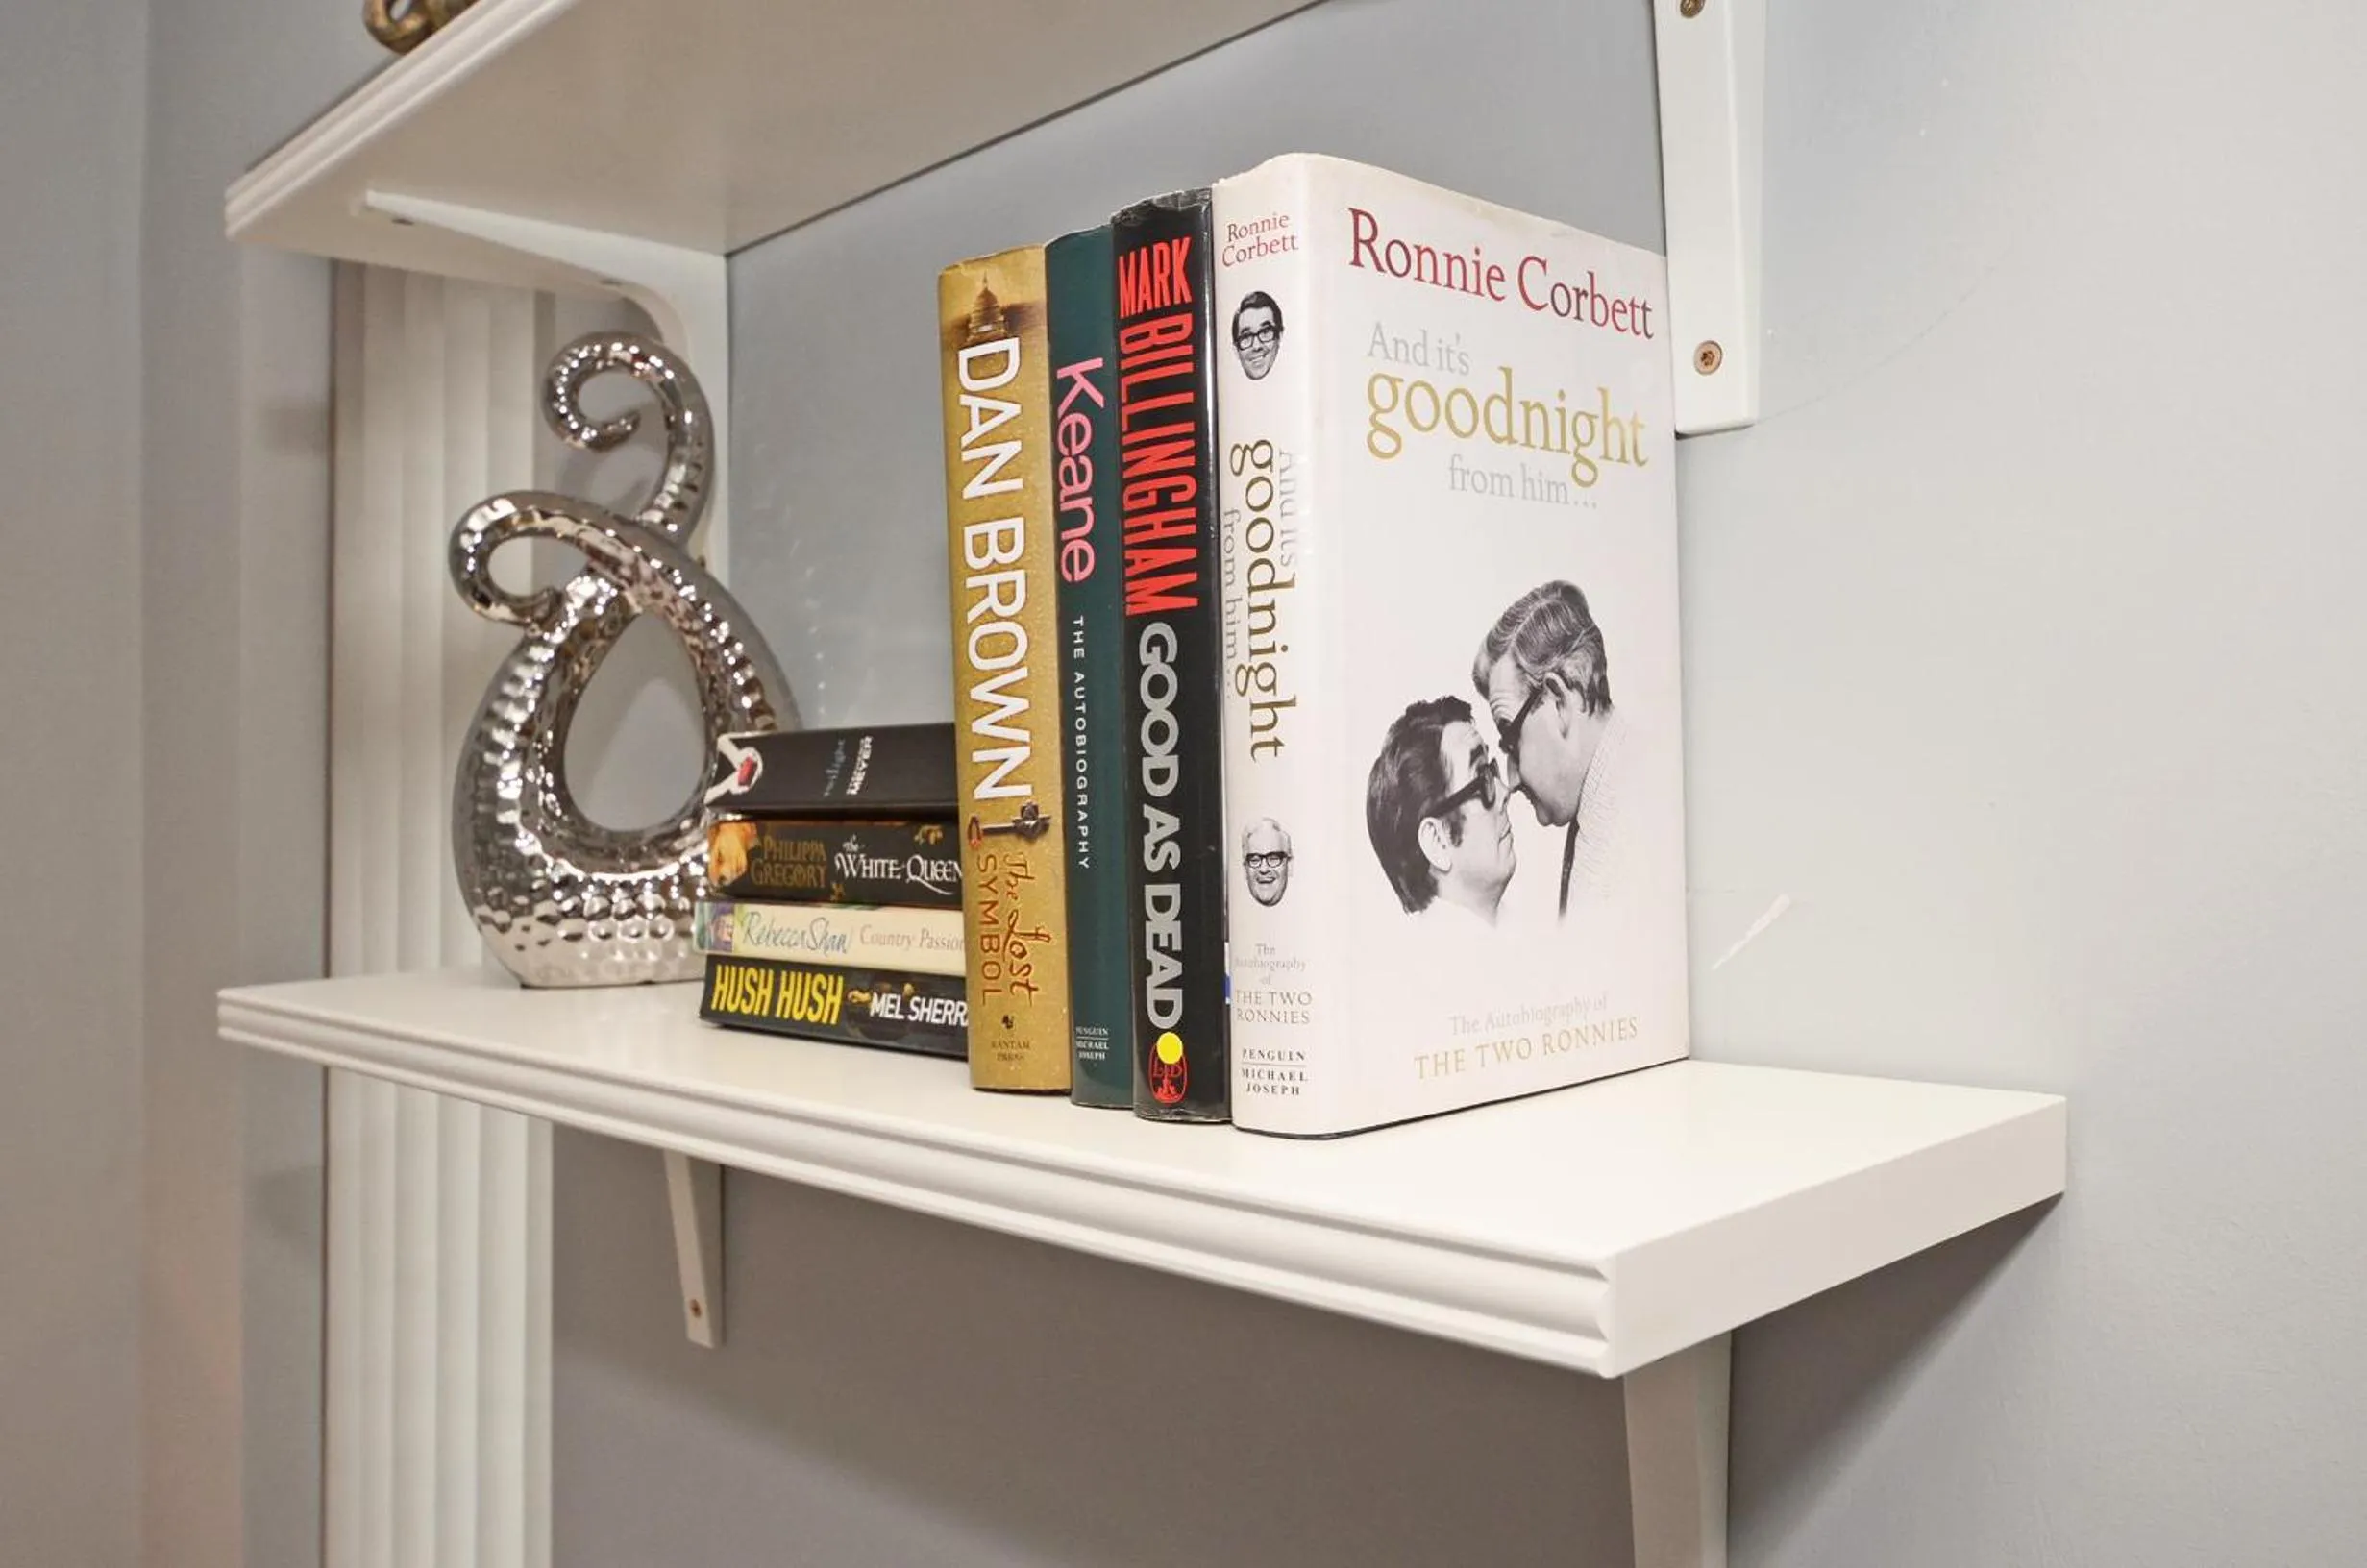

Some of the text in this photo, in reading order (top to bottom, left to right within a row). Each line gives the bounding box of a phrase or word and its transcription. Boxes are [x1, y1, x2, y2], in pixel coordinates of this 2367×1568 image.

[1221, 211, 1299, 267] Ronnie Corbett
[1348, 207, 1654, 339] Ronnie Corbett
[1367, 321, 1471, 377] And it's
[1119, 237, 1199, 616] MARK BILLINGHAM
[1366, 365, 1649, 488] goodnight
[1057, 357, 1105, 582] Keane
[1448, 453, 1516, 499] from
[957, 337, 1034, 800] DAN BROWN
[1223, 507, 1242, 590] from
[1229, 438, 1298, 763] goodnight
[1139, 621, 1181, 798] GOOD
[1073, 615, 1090, 869] THE AUTOBIOGRAPHY
[763, 835, 827, 862] PHILIPPA
[834, 852, 901, 879] WHITE
[1143, 804, 1181, 872] AS
[751, 859, 826, 888] GREGORY
[742, 911, 806, 948] Rebecca
[860, 924, 912, 950] Country
[977, 854, 1002, 1006] SYMBOL
[1003, 852, 1052, 1007] The Lost
[1145, 884, 1184, 1030] DEAD
[711, 964, 844, 1025] HUSH HUSH
[870, 992, 969, 1026] MEL SHERR
[1235, 990, 1313, 1007] THE TWO
[1236, 1008, 1310, 1025] RONNIES
[1448, 1014, 1481, 1036] The
[1485, 994, 1590, 1034] Autobiography
[1241, 1067, 1308, 1082] MICHAEL
[1242, 1046, 1306, 1062] PENGUIN
[1413, 1016, 1639, 1080] THE TWO RONNIES
[1245, 1083, 1300, 1096] JOSEPH
